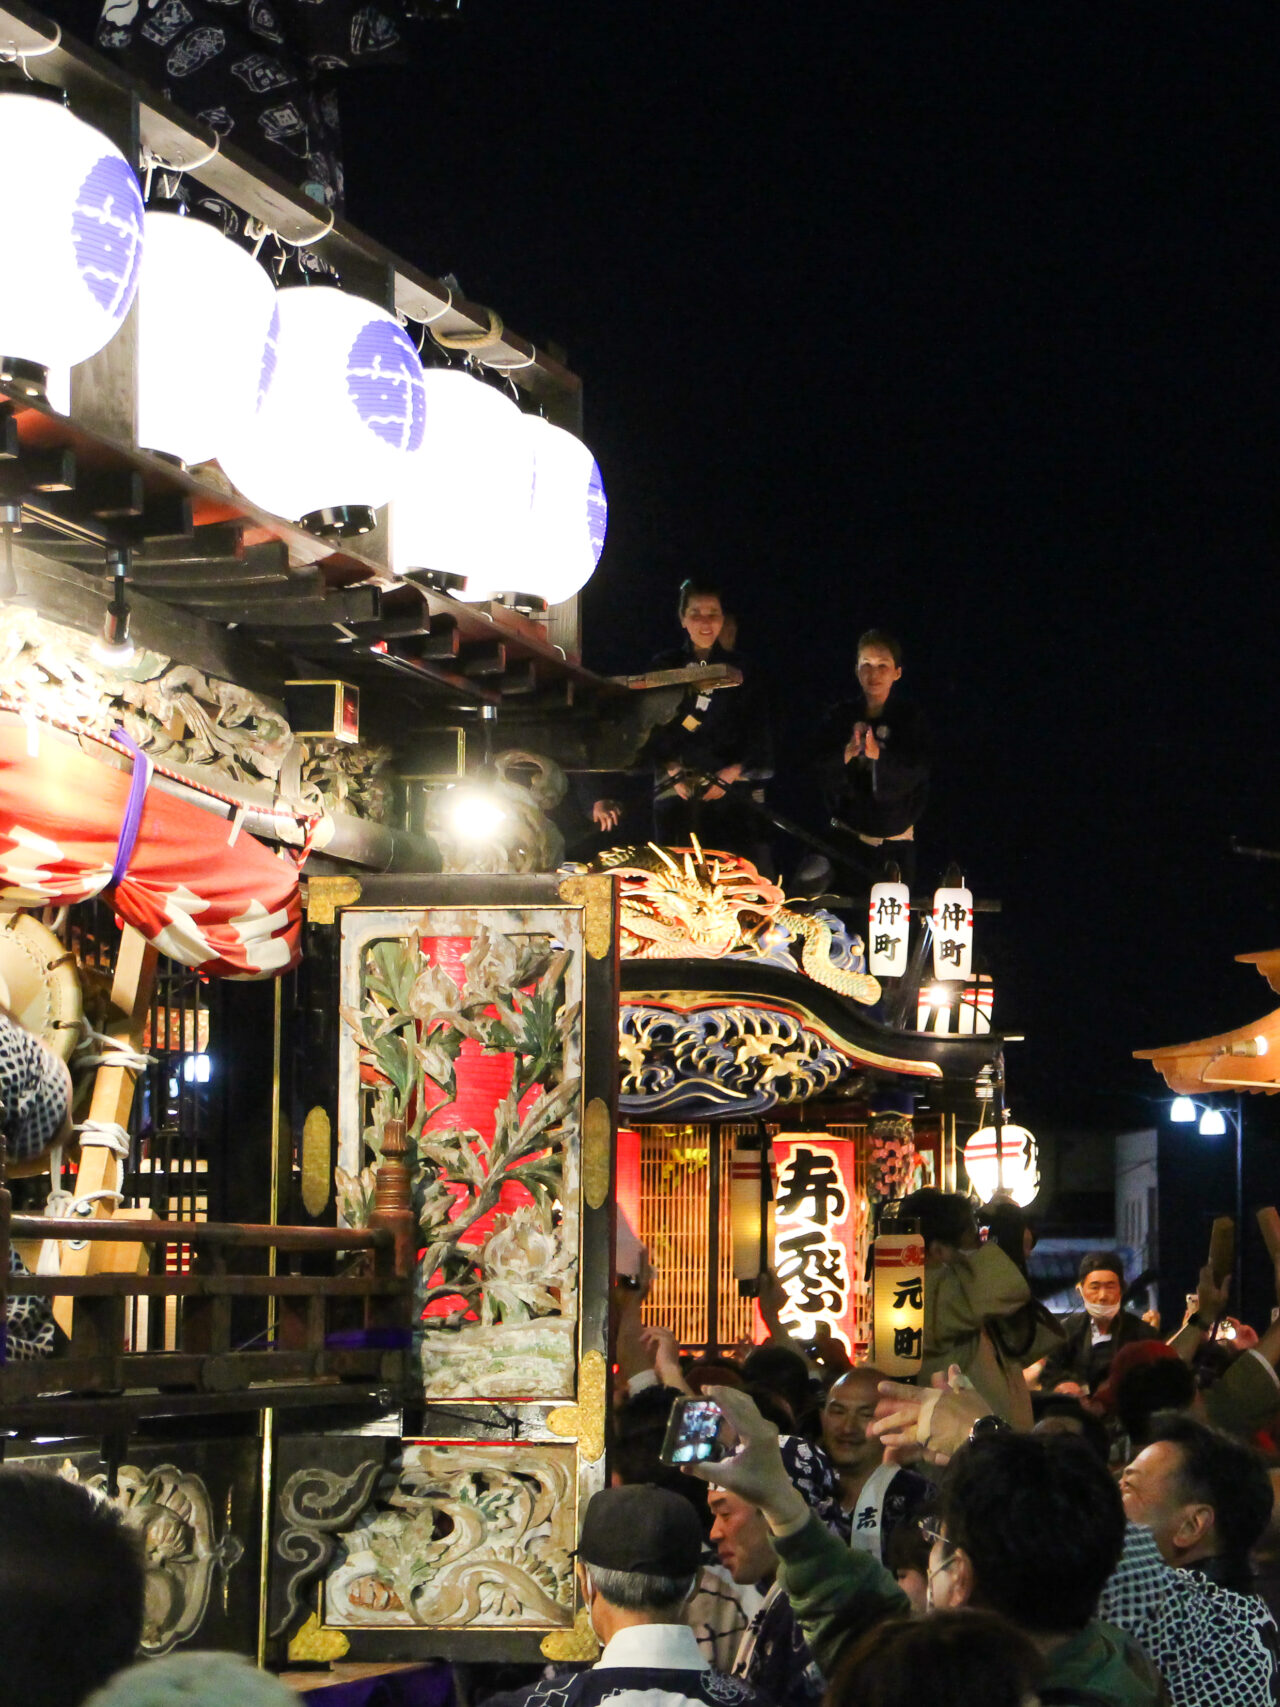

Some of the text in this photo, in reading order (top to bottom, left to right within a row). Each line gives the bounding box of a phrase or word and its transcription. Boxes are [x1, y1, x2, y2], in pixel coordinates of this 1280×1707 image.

[874, 897, 902, 961] 仲町
[939, 903, 967, 967] 仲町
[893, 1276, 923, 1360] 元町
